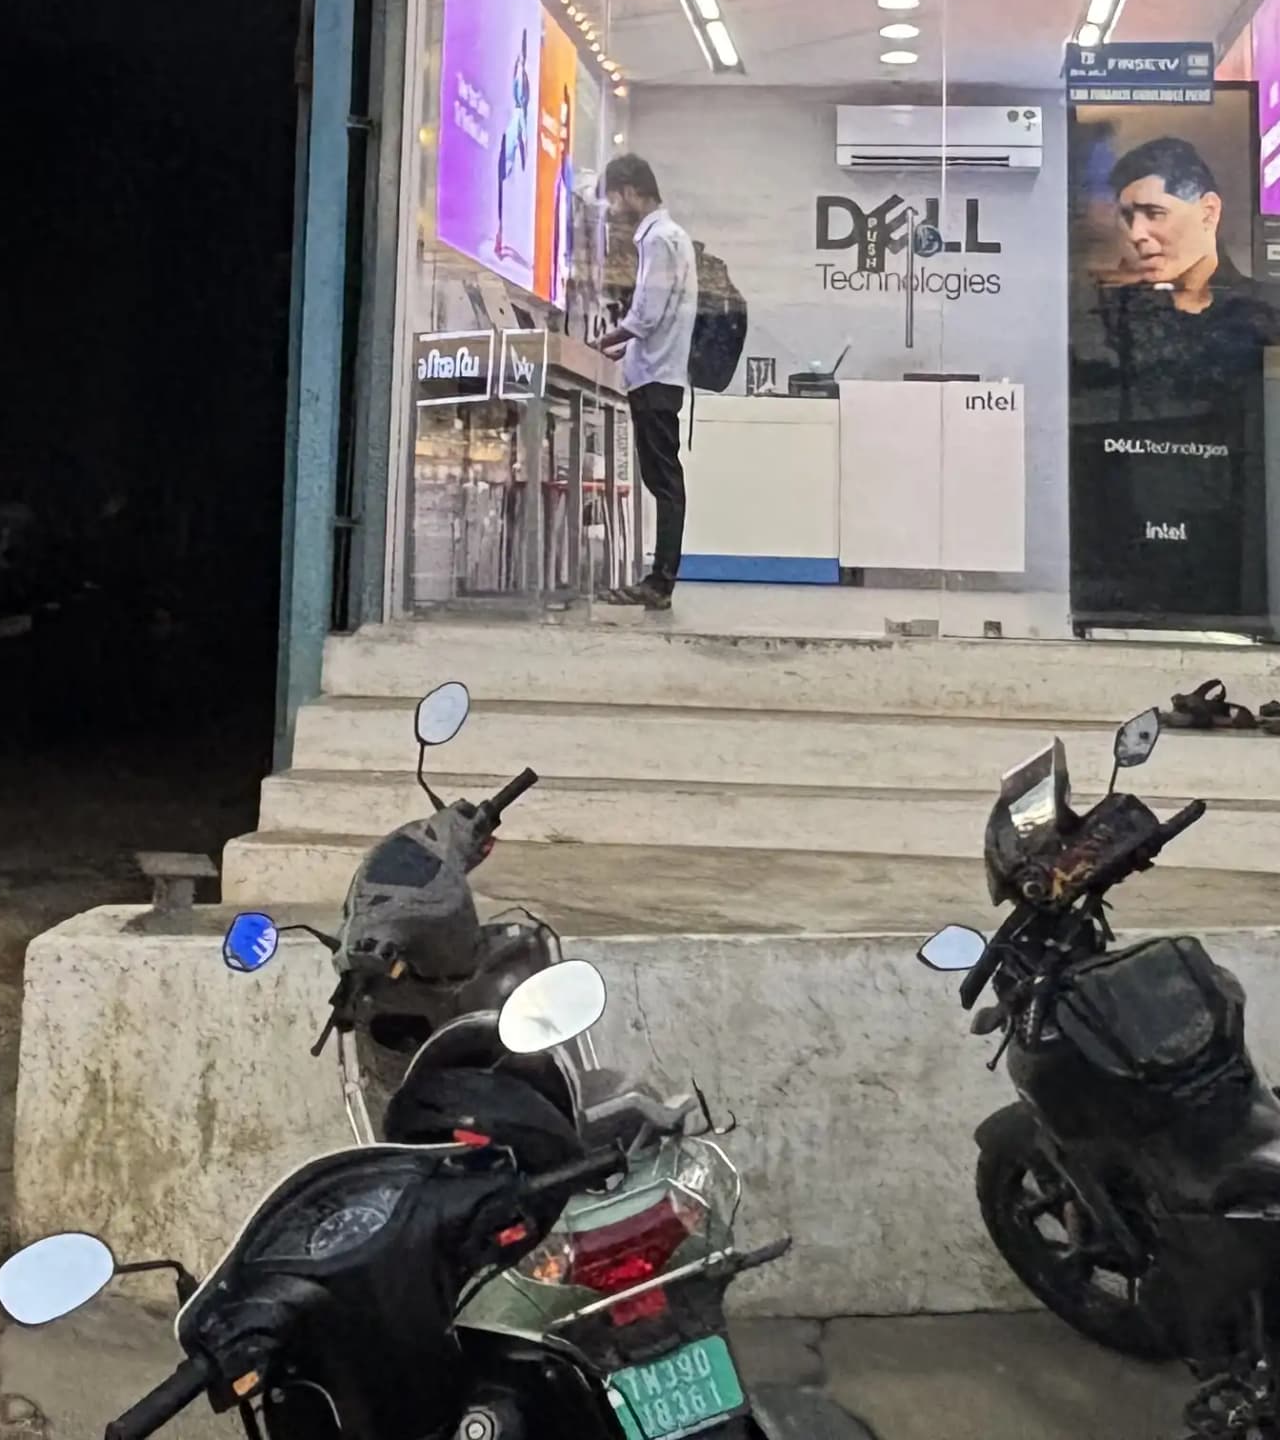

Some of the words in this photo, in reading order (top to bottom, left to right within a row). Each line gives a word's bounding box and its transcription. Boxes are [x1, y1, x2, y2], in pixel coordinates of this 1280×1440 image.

[815, 193, 1002, 255] DELL
[965, 390, 1019, 413] intel
[1145, 520, 1188, 542] intel
